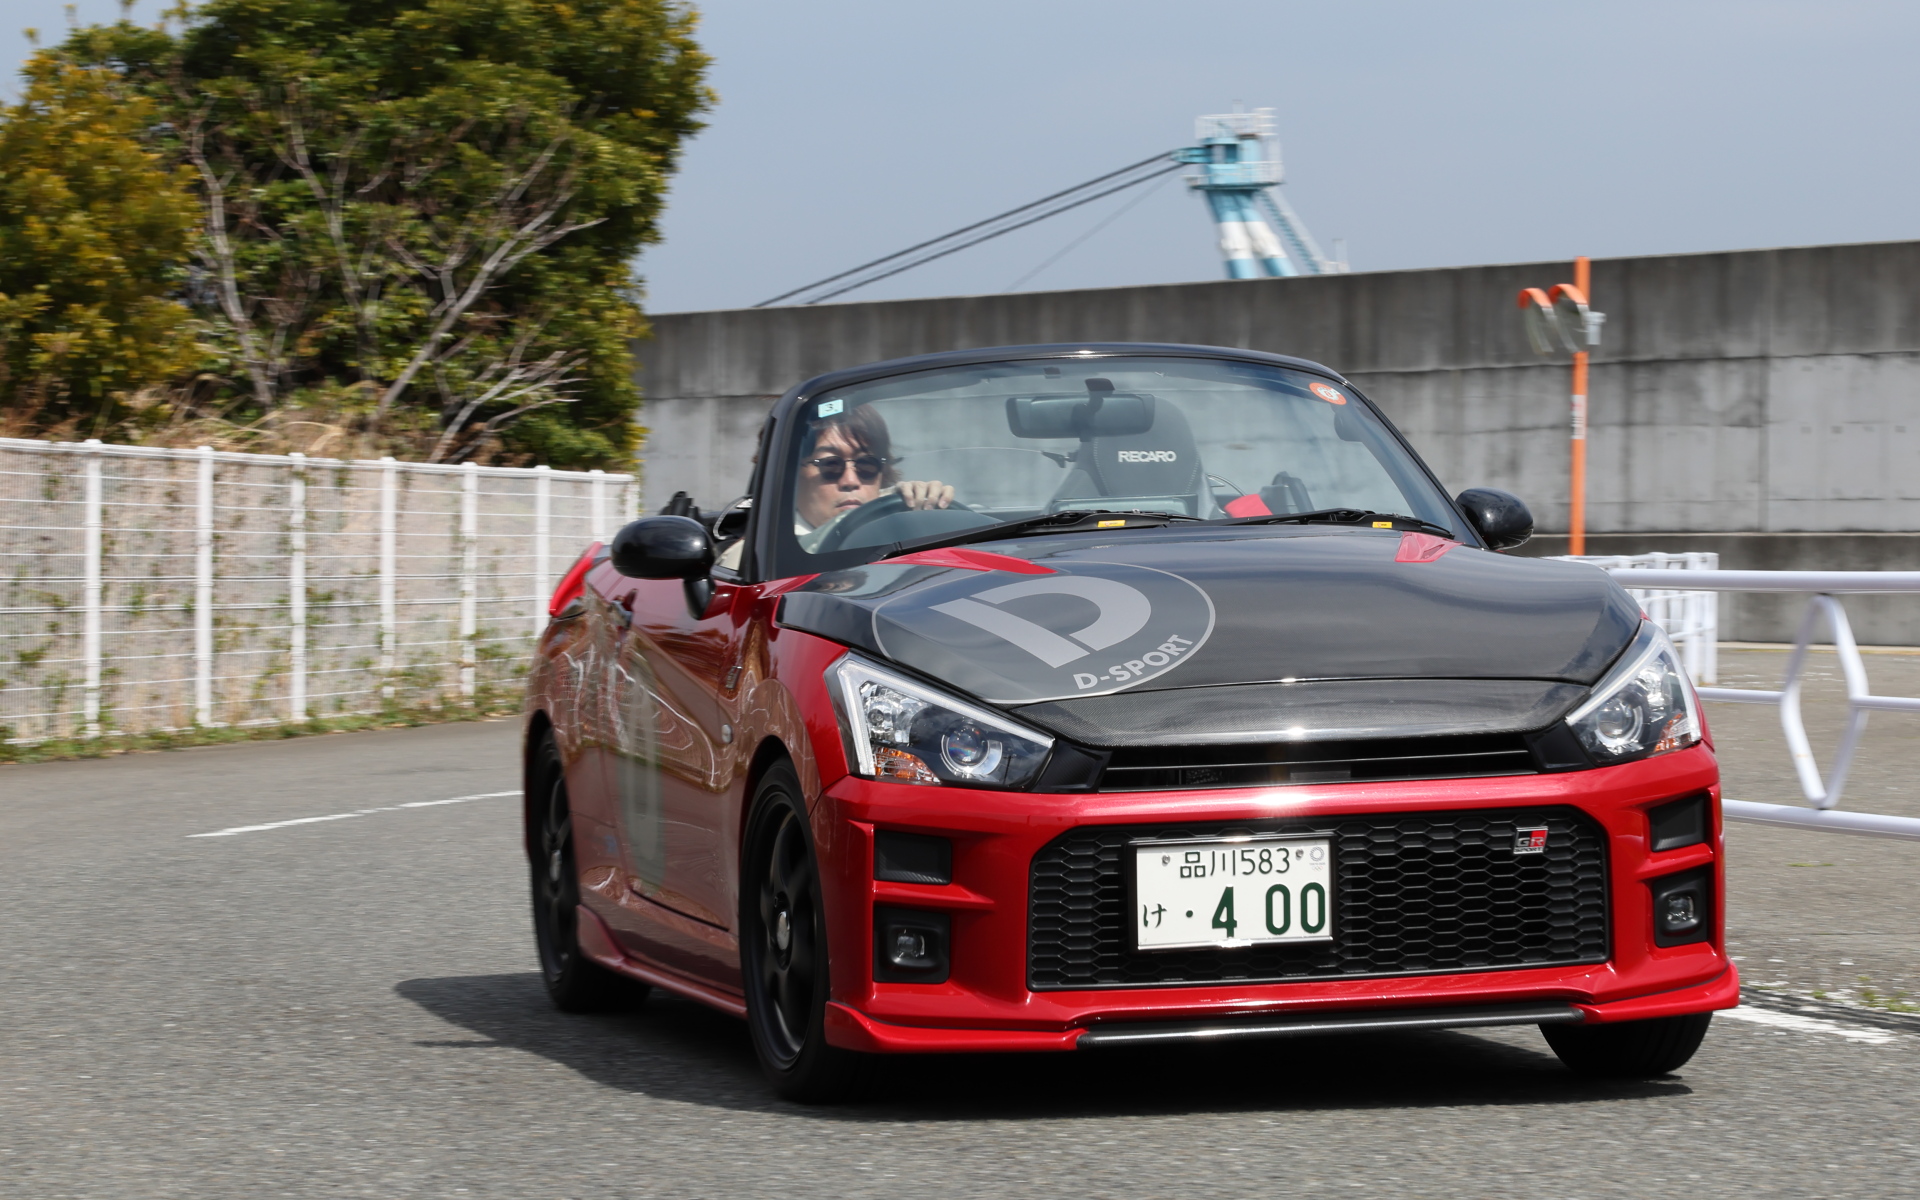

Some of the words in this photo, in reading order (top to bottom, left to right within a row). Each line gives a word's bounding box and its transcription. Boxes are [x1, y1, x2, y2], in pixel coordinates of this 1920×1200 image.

[1117, 450, 1177, 463] RECARO
[1072, 633, 1194, 691] D-SPORT
[1516, 837, 1545, 848] GR
[1143, 903, 1168, 928] け
